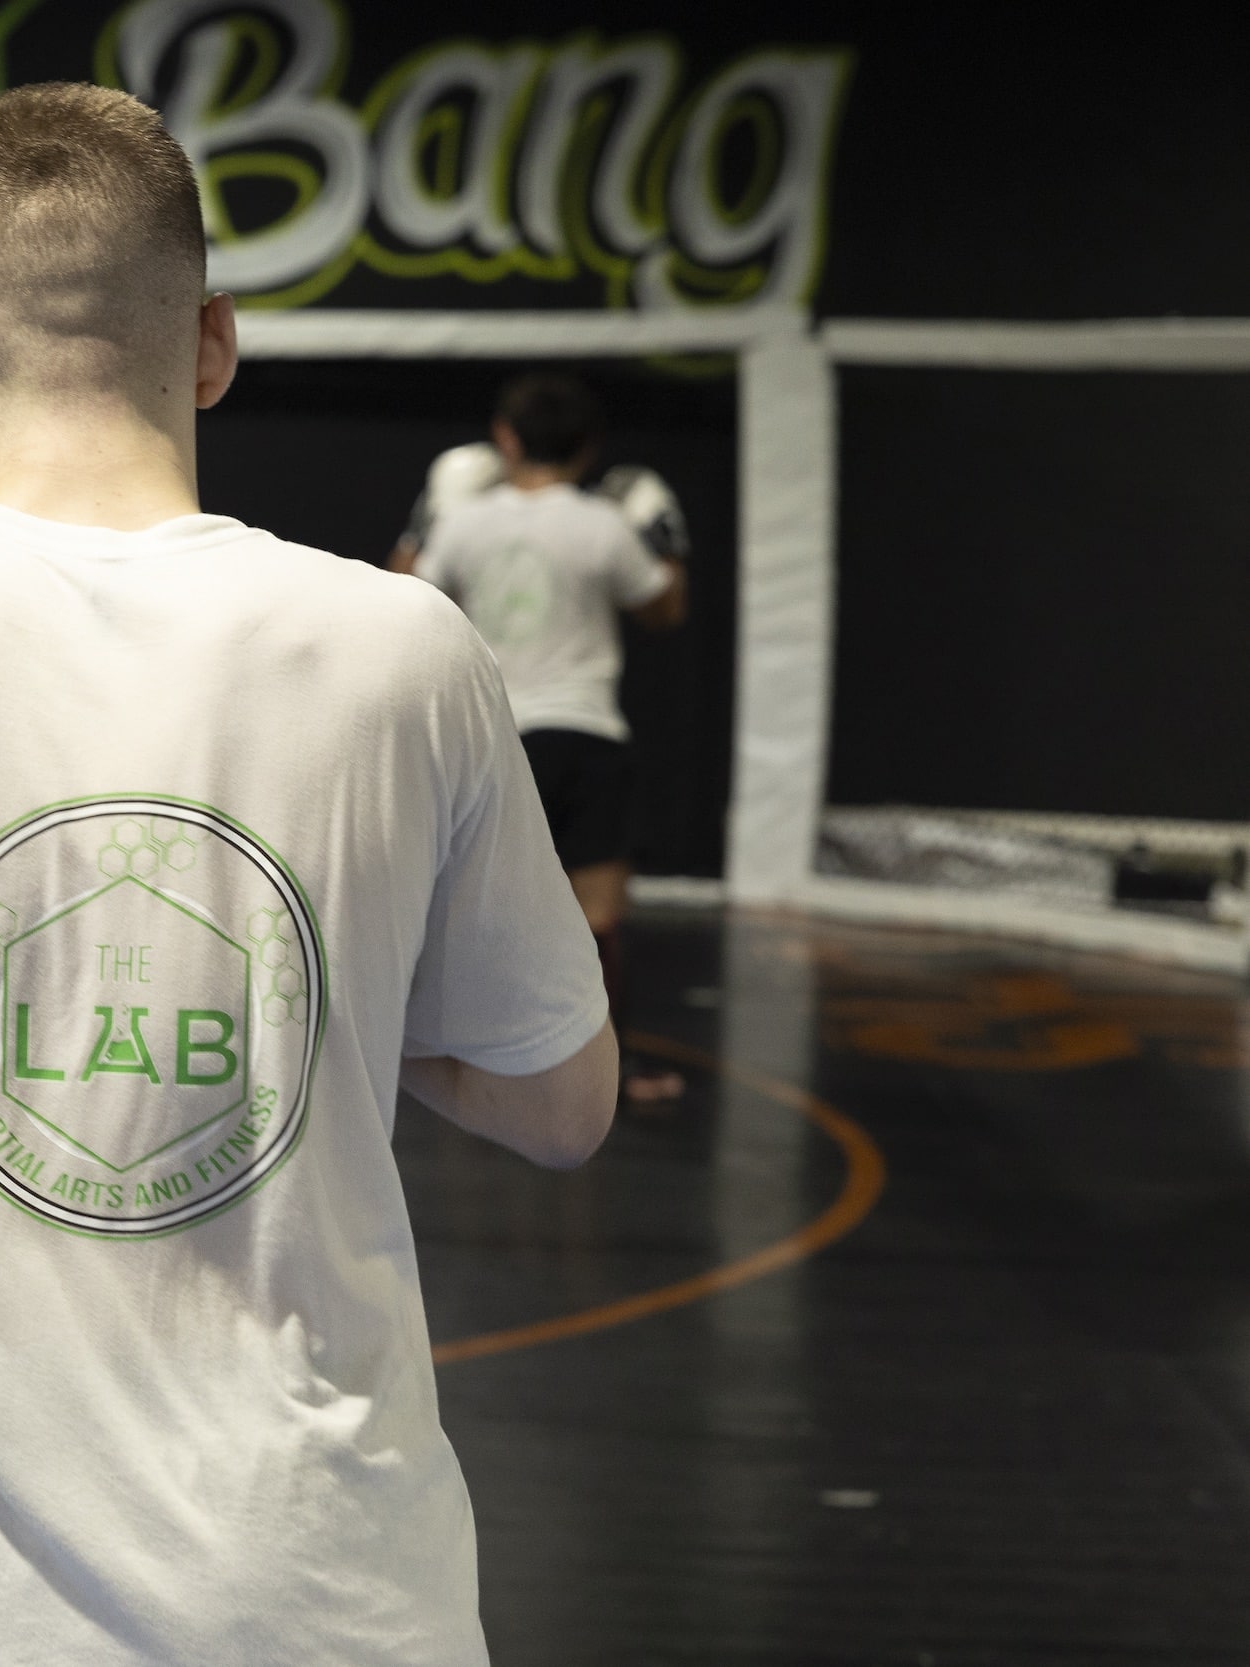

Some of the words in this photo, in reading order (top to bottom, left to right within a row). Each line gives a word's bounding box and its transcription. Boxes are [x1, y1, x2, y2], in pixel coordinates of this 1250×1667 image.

[100, 0, 850, 325] Bang
[95, 944, 153, 984] THE
[15, 1002, 239, 1087] LAB
[50, 1173, 125, 1209] ARTS
[135, 1171, 193, 1209] AND
[194, 1084, 279, 1184] FITNESS
